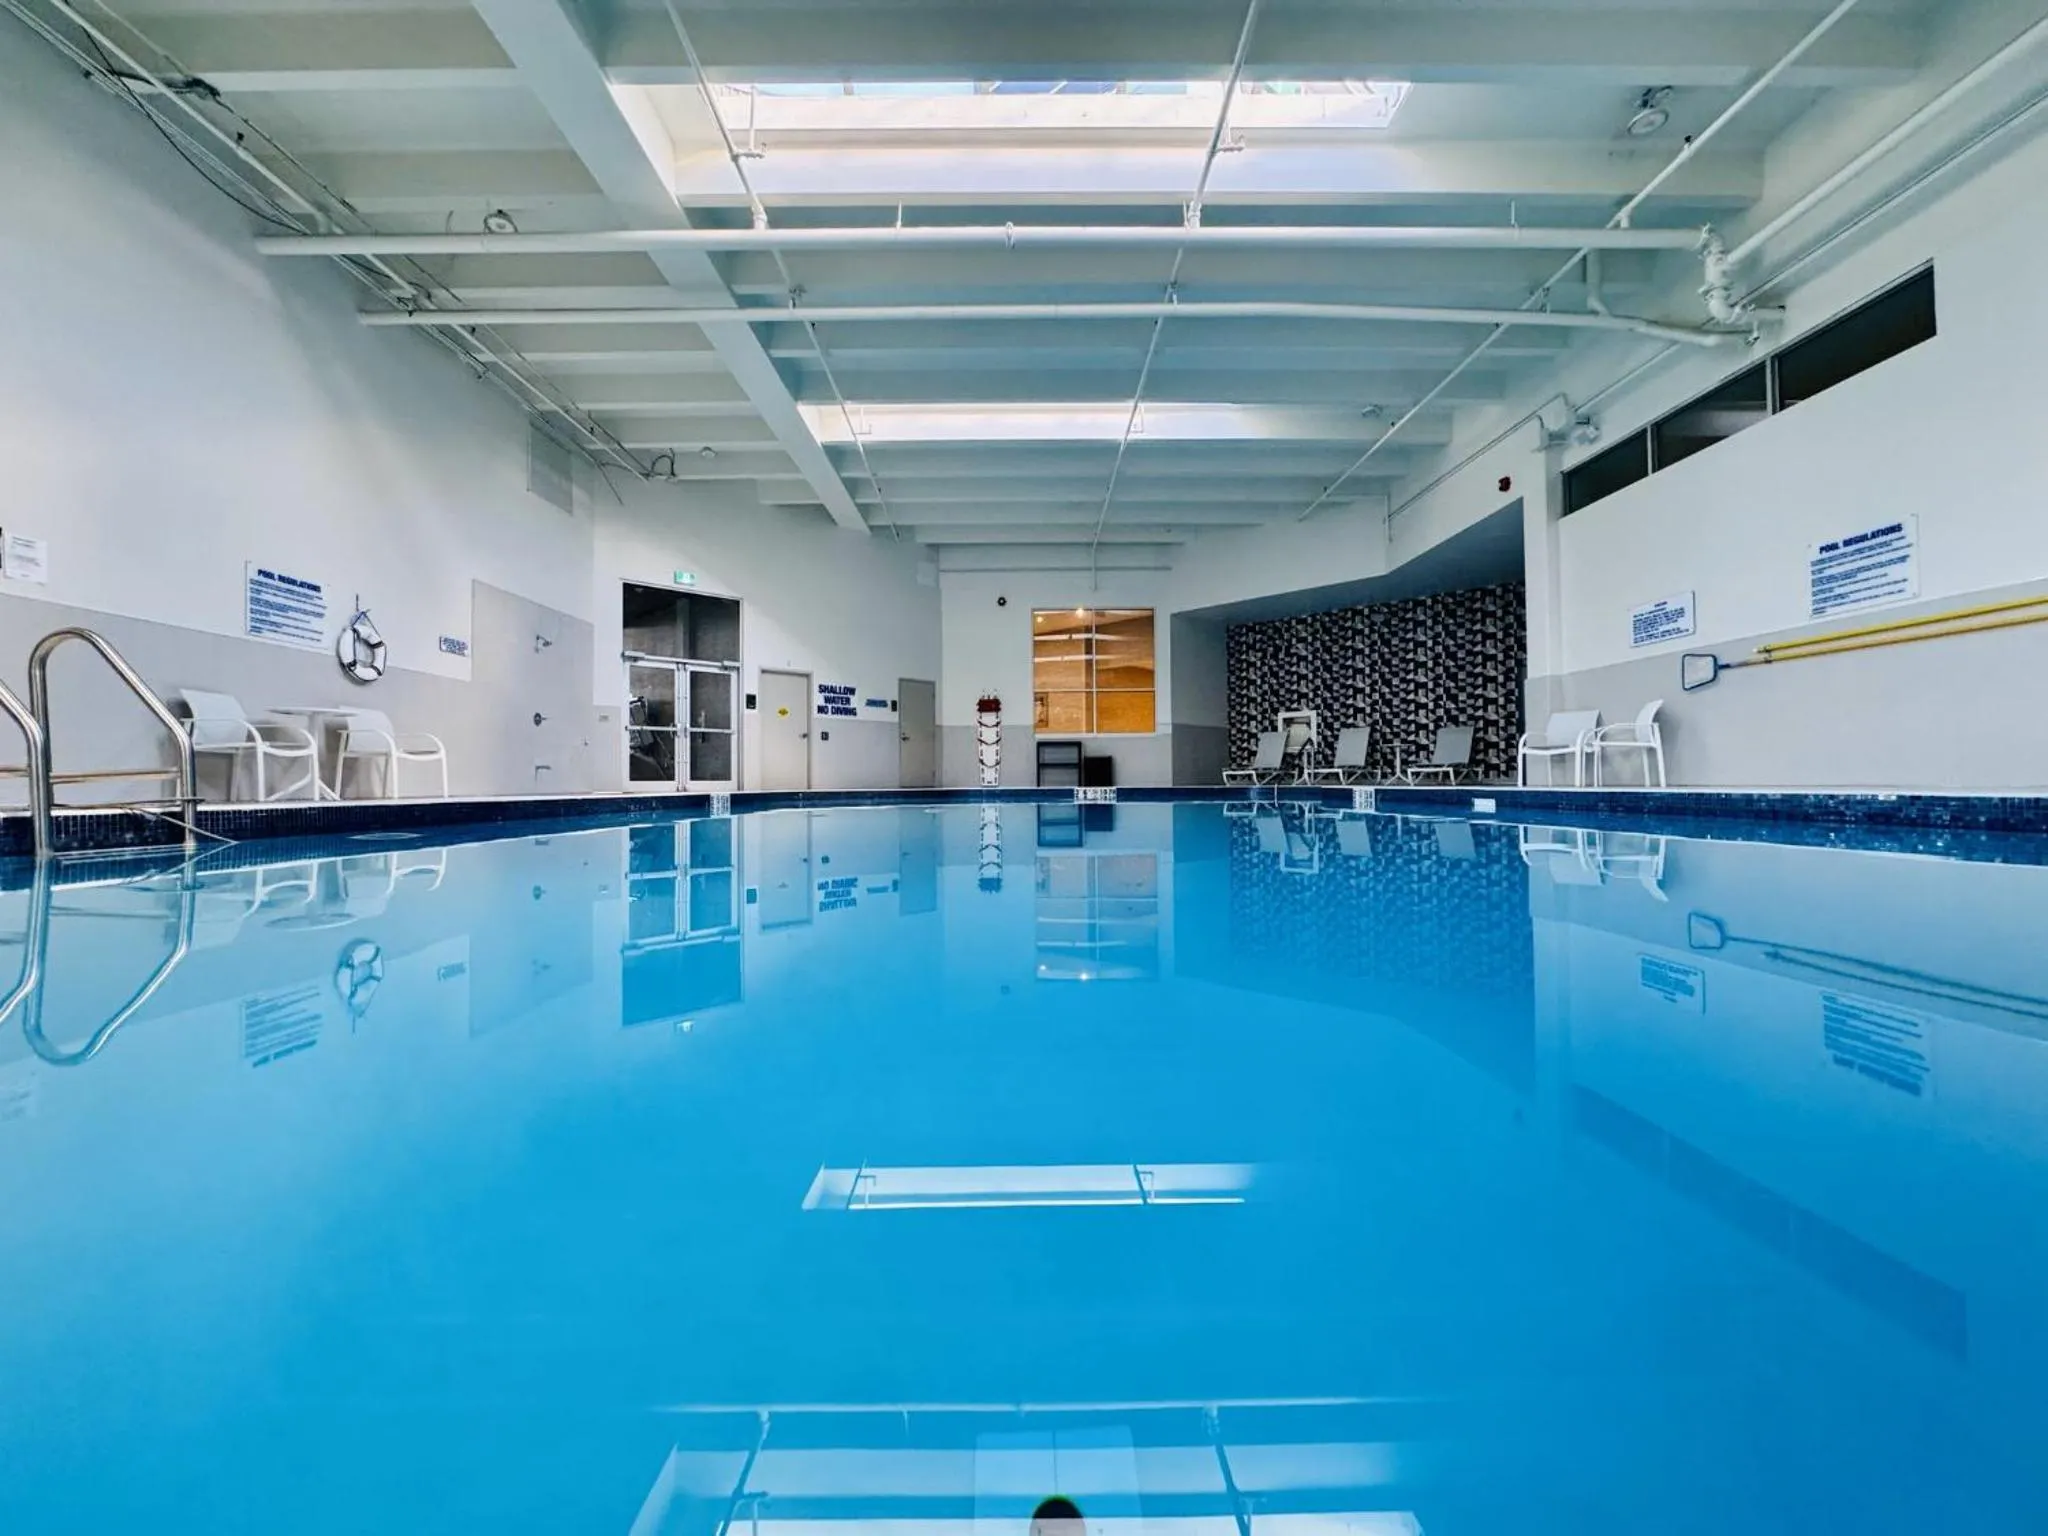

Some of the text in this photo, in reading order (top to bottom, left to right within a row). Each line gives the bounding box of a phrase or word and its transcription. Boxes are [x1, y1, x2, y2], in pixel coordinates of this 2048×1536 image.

[1819, 523, 1903, 554] POOL REGULATIONS
[818, 684, 856, 696] SHALLOW
[824, 695, 851, 706] WATER
[817, 705, 857, 716] NO DIVING
